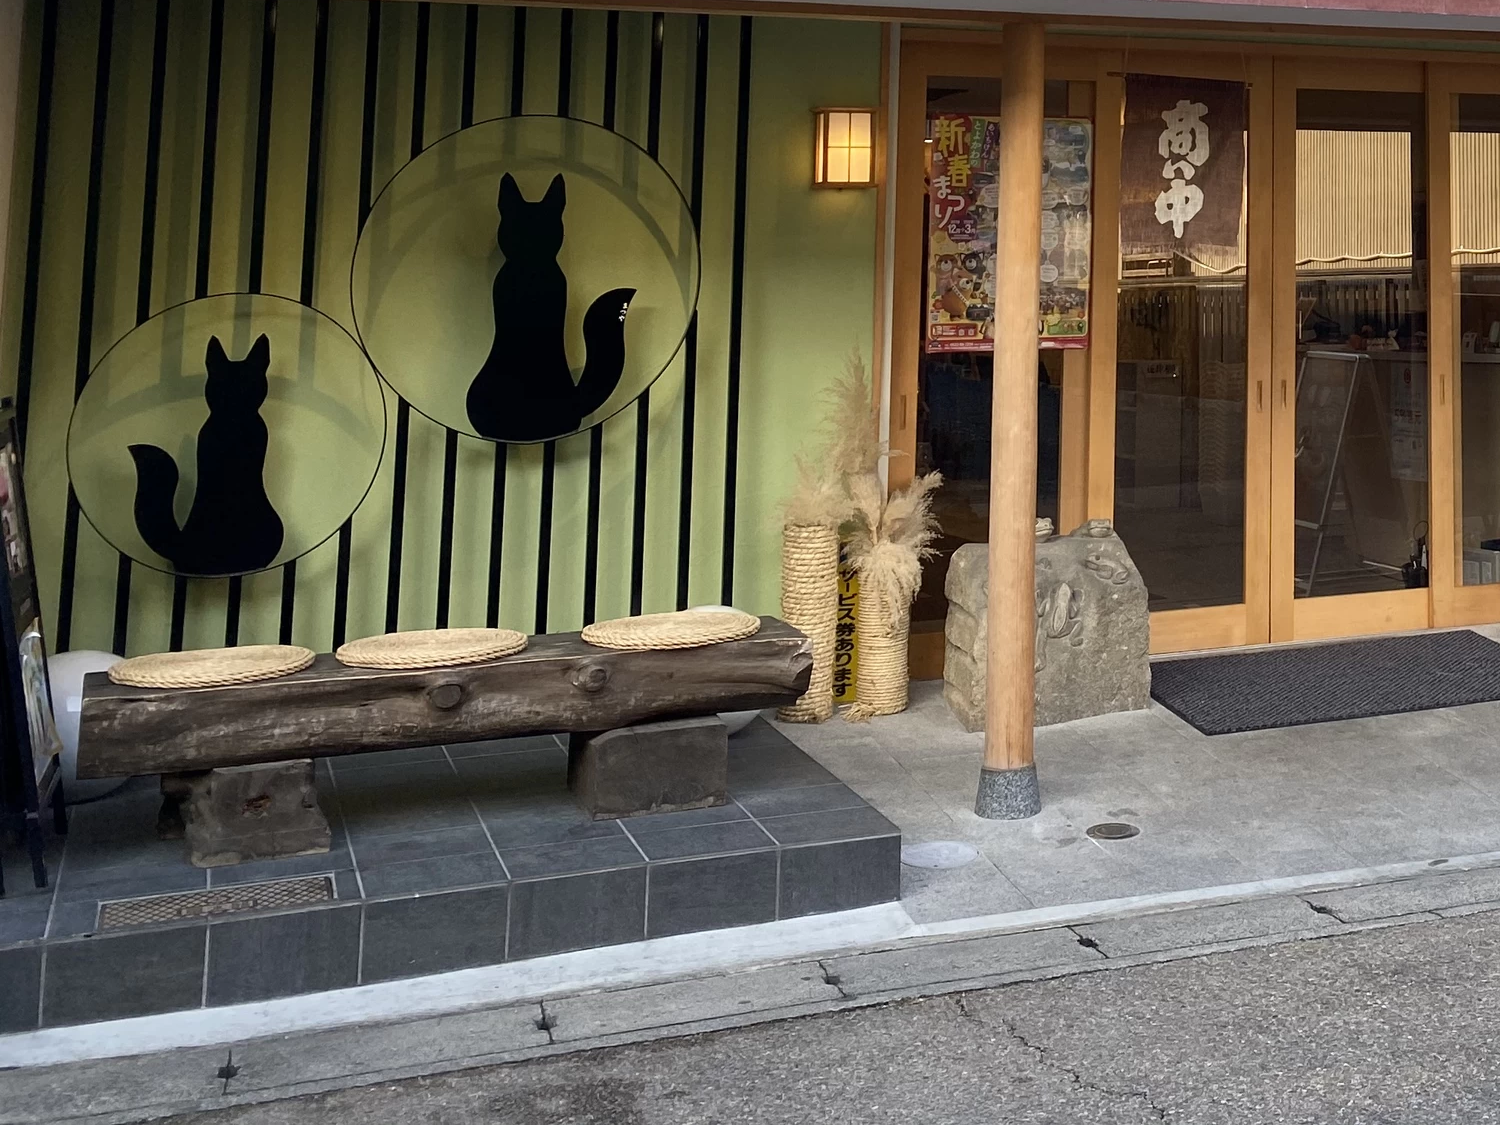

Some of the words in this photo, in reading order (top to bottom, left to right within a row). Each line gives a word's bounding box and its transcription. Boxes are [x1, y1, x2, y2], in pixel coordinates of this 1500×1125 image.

[934, 116, 971, 187] 新春
[1154, 99, 1210, 239] 商い中
